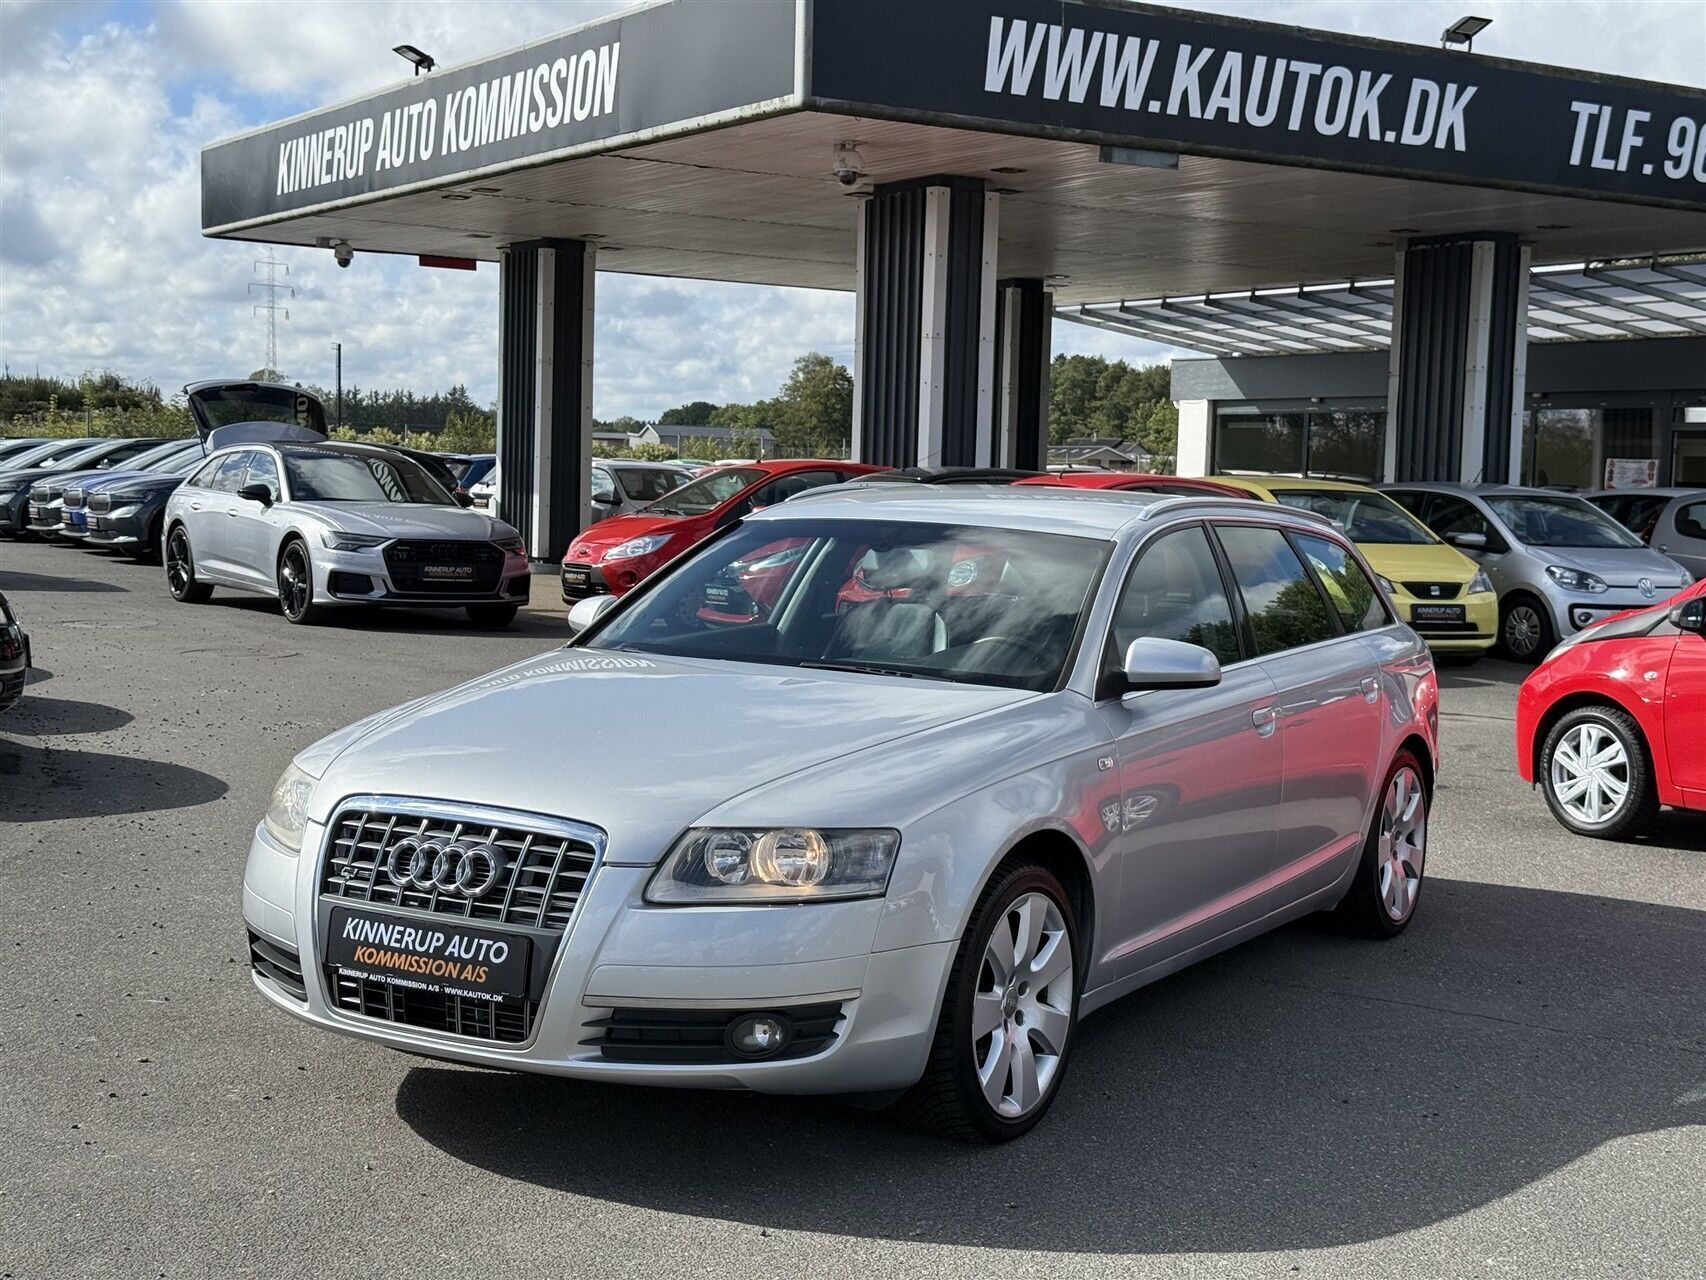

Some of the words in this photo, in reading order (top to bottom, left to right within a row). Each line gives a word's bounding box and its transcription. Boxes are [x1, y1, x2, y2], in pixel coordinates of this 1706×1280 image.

[984, 15, 1478, 152] WWW.KAUTOK.DK
[276, 117, 374, 196] KINNERUP
[375, 98, 437, 172] AUTO
[442, 42, 621, 156] KOMMISSION
[1569, 101, 1653, 175] TLF.
[342, 917, 445, 954] KINNERUP
[444, 934, 509, 964] AUTO
[354, 945, 461, 979] KOMMISSION
[460, 964, 489, 983] A/S
[338, 967, 369, 979] KINNERUP
[368, 973, 386, 983] AUTO
[386, 977, 427, 990] KOMMISSION
[428, 984, 440, 992] A/S
[444, 986, 504, 1003] WWW.KAUTOK.DK
